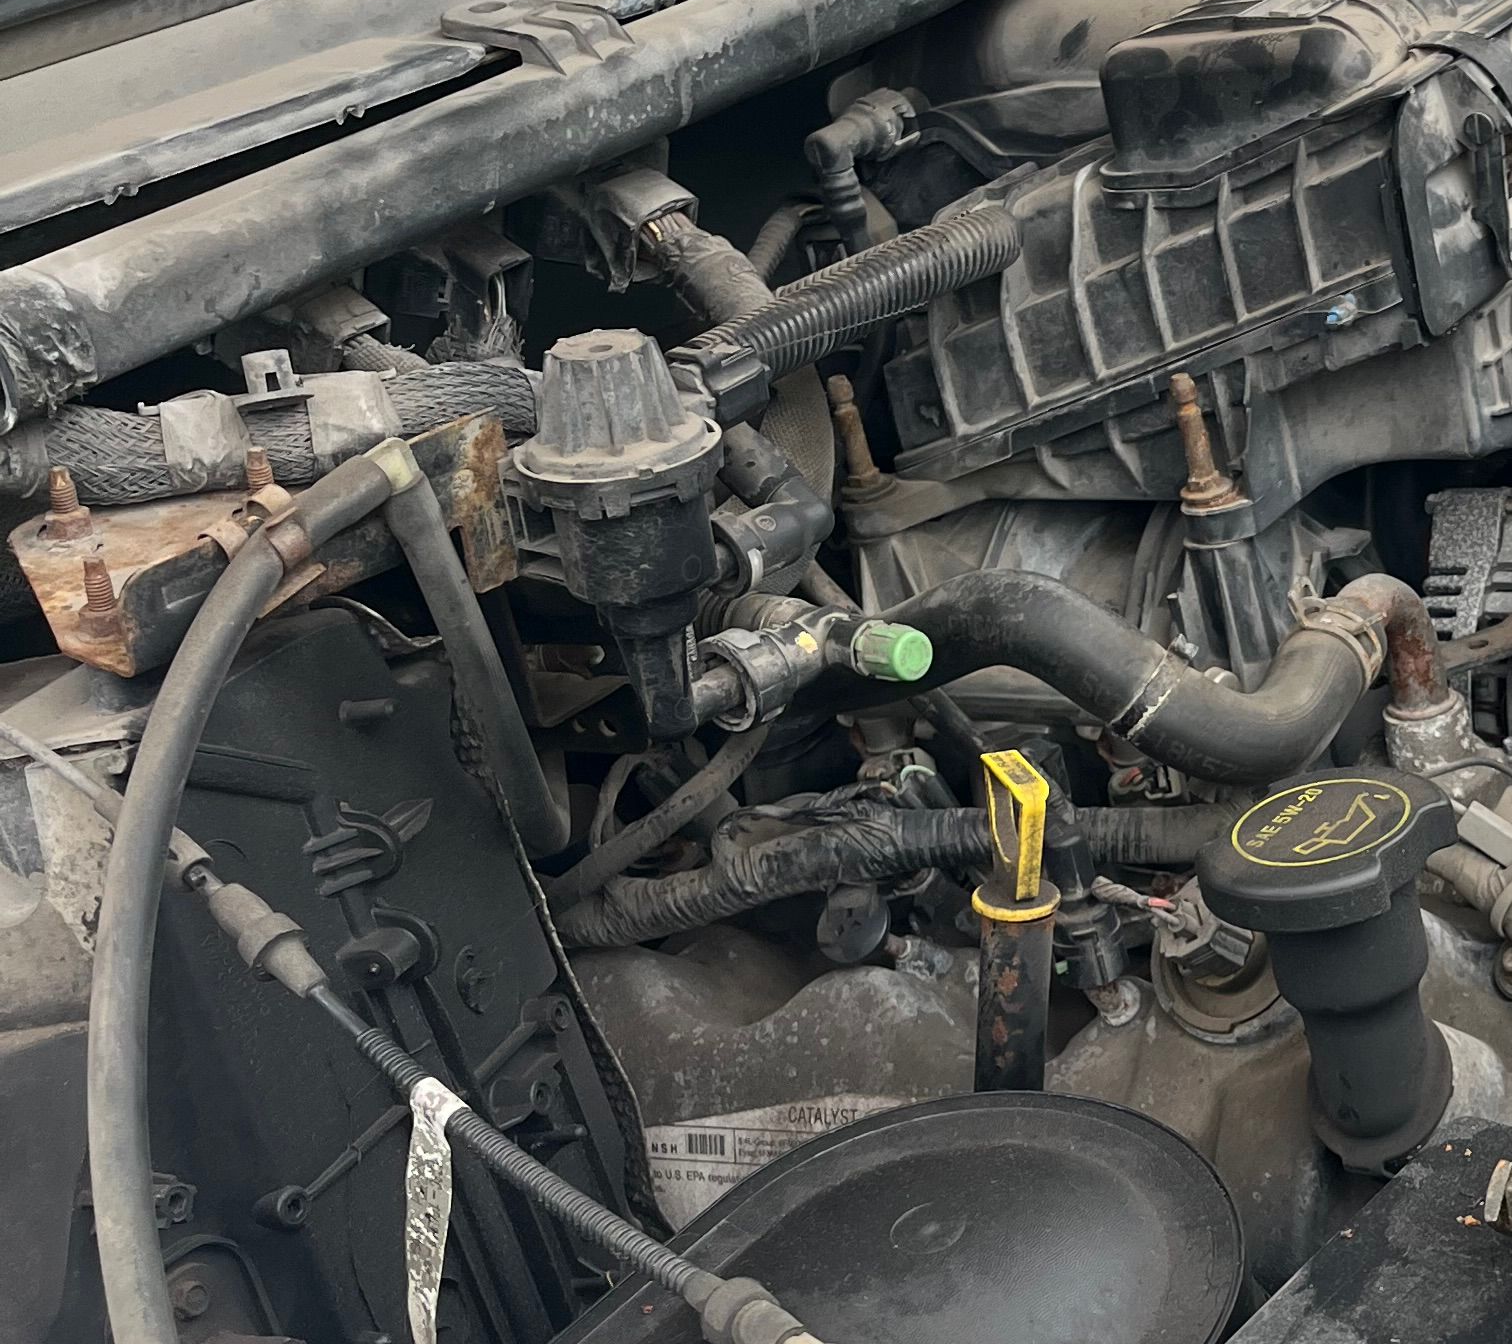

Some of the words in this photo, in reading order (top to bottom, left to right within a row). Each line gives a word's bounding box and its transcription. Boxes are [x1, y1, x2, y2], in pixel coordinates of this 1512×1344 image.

[1246, 825, 1282, 847] SAE
[1271, 788, 1323, 824] 5W-20
[788, 1106, 858, 1128] CATALYST
[686, 1170, 705, 1182] EPA
